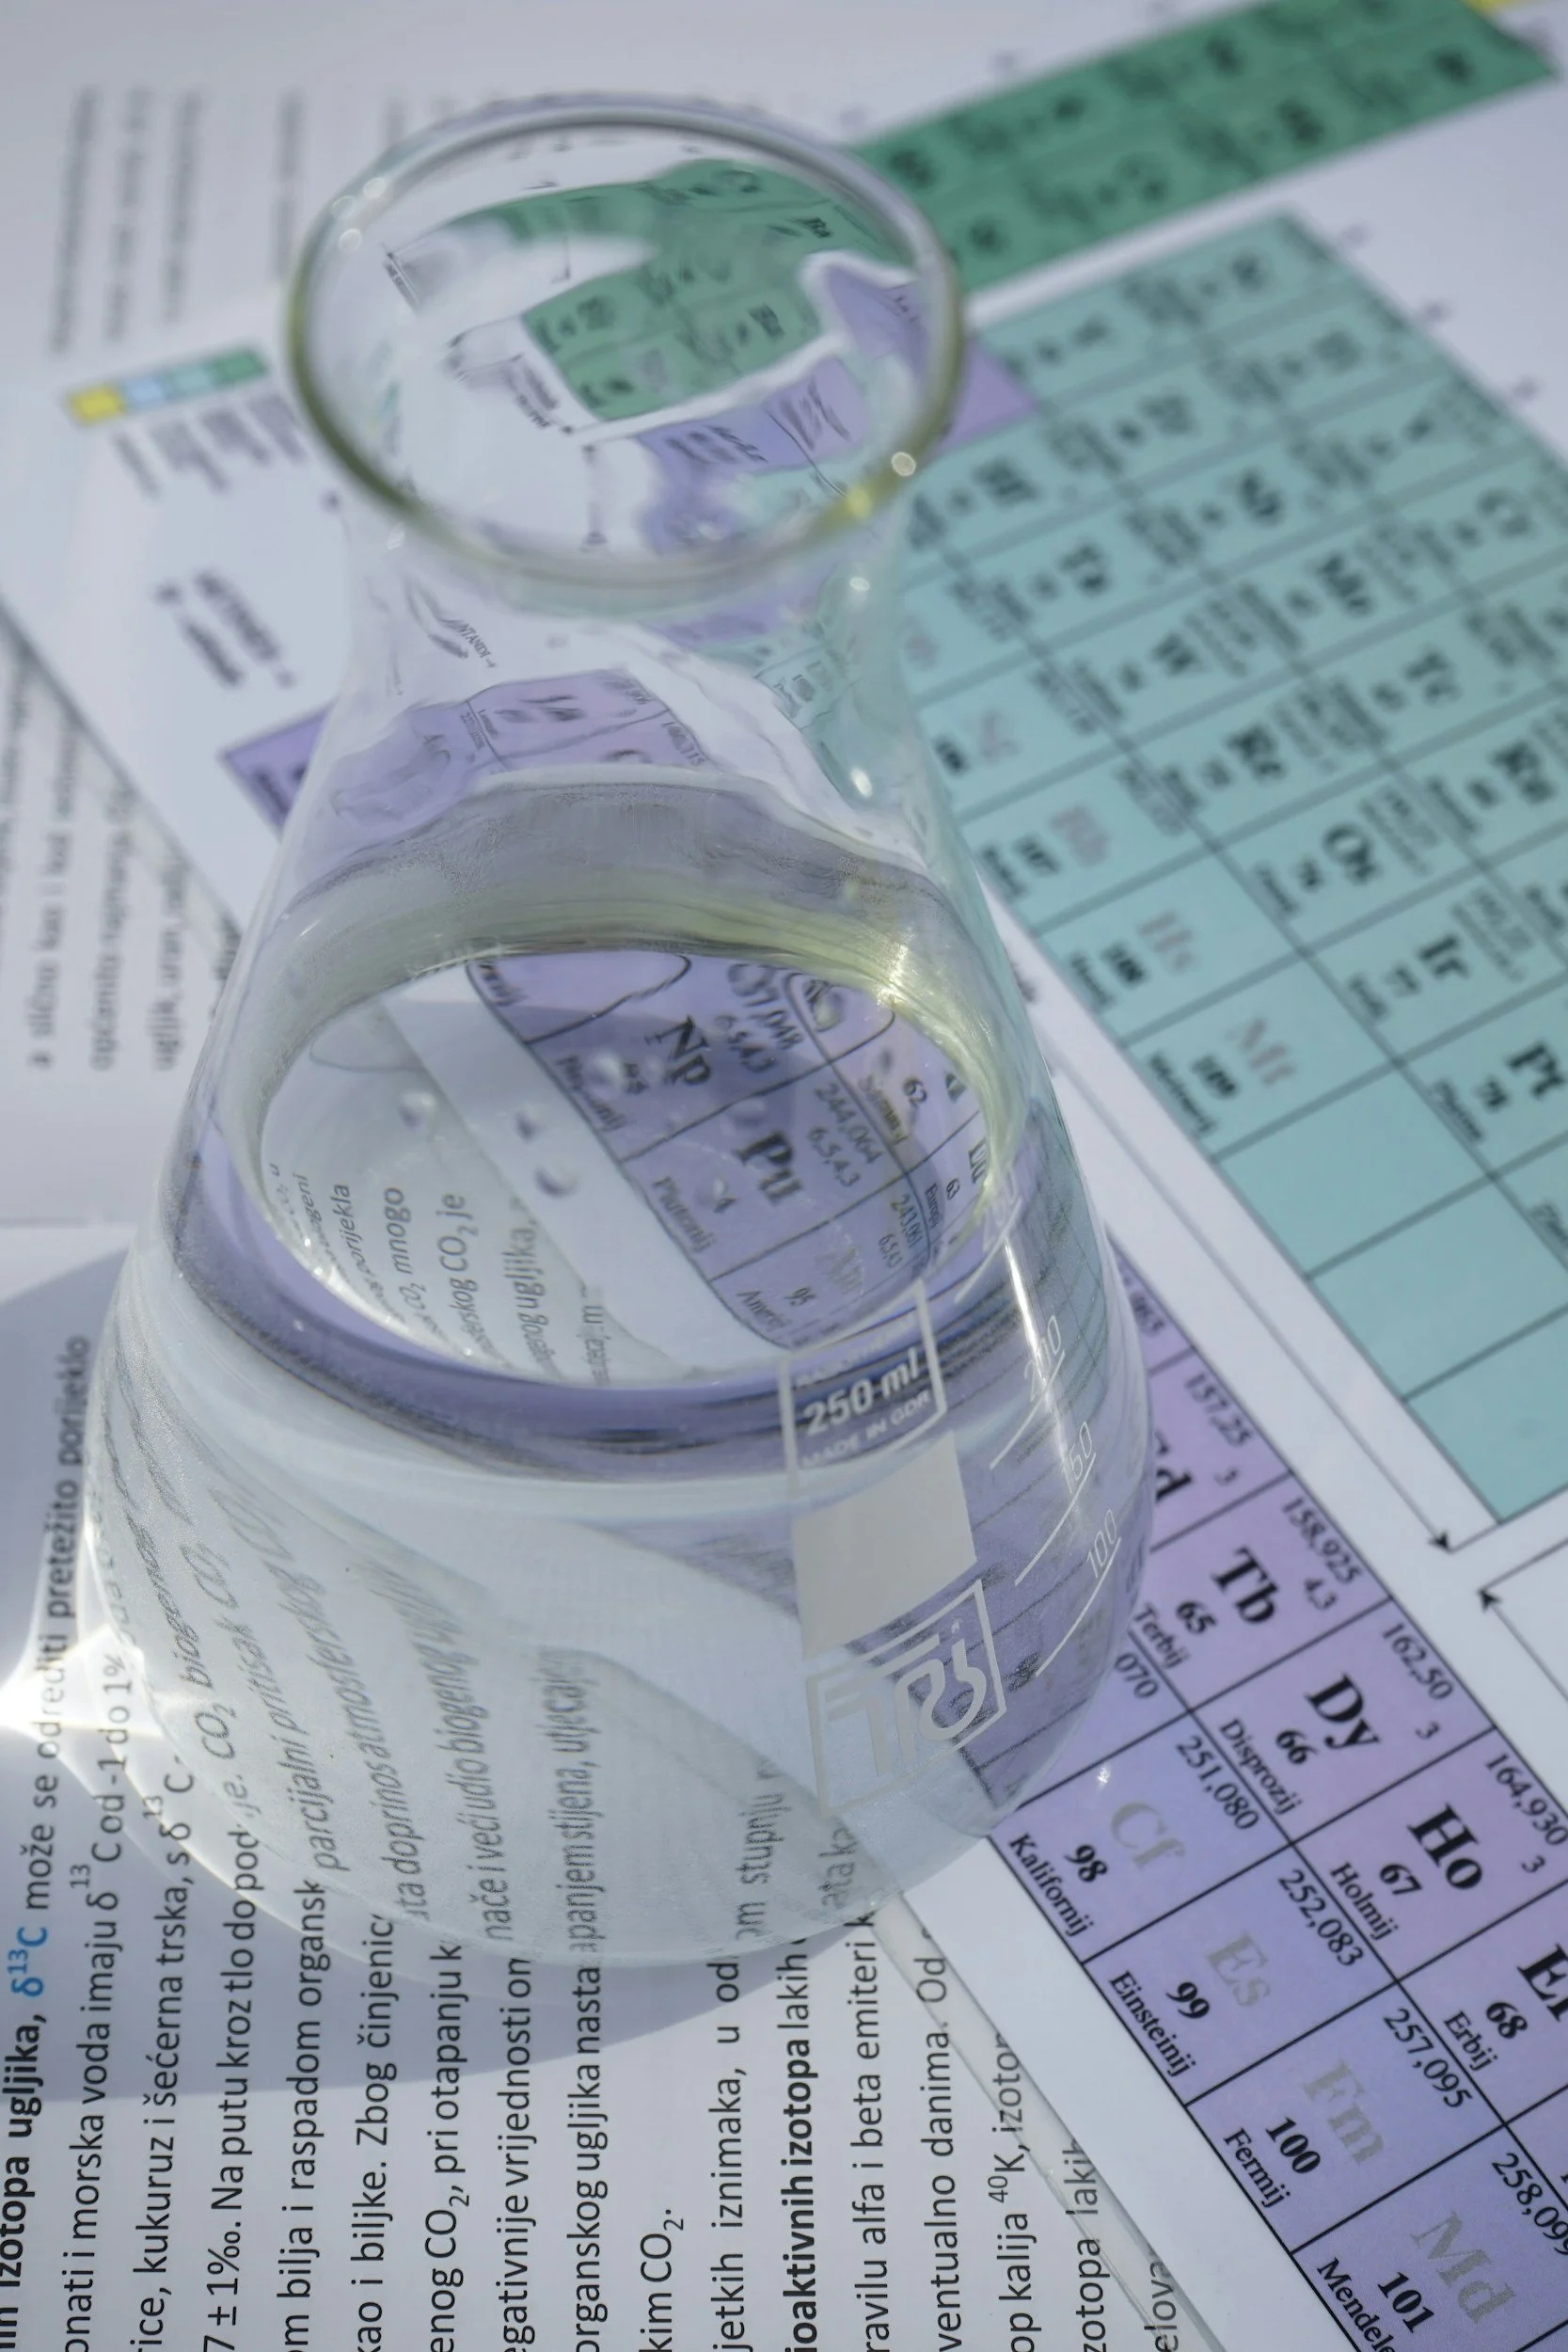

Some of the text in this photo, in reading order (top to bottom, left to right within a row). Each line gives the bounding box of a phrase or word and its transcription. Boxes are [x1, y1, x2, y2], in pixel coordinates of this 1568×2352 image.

[645, 1016, 712, 1086] Np
[814, 1084, 884, 1165] 244,064
[902, 1077, 928, 1109] 62
[734, 1132, 805, 1206] Pu
[381, 1187, 414, 1274] mnogo
[435, 1193, 479, 1272] CO2 je
[57, 1337, 90, 1467] porijeklo
[803, 1378, 873, 1437] 250
[880, 1346, 919, 1400] ml
[1183, 1373, 1254, 1449] 157,25
[1213, 1468, 1237, 1487] 3
[39, 1476, 82, 1618] pretežito
[1086, 1509, 1118, 1579] 100
[1280, 1495, 1364, 1585] 158,925
[1175, 1598, 1217, 1637] 65
[1212, 1546, 1282, 1629] Tb
[1303, 1577, 1337, 1612] 4,3
[1133, 1604, 1190, 1671] Terbij
[1383, 1622, 1453, 1702] 162,50
[28, 1629, 71, 1762] odrediti
[95, 1706, 131, 1747] do
[1307, 1674, 1382, 1750] Dy
[1416, 1721, 1440, 1740] 3
[97, 1759, 125, 1785] -1
[445, 1758, 492, 1809] udio
[1176, 1734, 1259, 1831] 251,080
[1219, 1718, 1304, 1816] Disprozij
[1276, 1727, 1319, 1766] 66
[34, 1775, 58, 1808] se
[97, 1795, 124, 1835] od
[272, 1735, 350, 1871] parcijalni
[361, 1764, 425, 1875] doprinos
[1485, 1753, 1568, 1847] 164,930
[21, 1825, 54, 1910] može
[166, 1851, 190, 1866] s
[456, 1814, 504, 1859] veći
[1065, 1843, 1108, 1883] 98
[1111, 1802, 1186, 1871] Cf
[1407, 1803, 1483, 1890] Ho
[1523, 1853, 1544, 1876] 3
[1008, 1833, 1095, 1939] Kalifornij
[1277, 1869, 1366, 1967] 252,083
[1329, 1862, 1399, 1940] Holmij
[1378, 1861, 1422, 1898] 67
[154, 1878, 193, 1965] trska,
[223, 1900, 256, 1940] do
[80, 1922, 123, 2011] imaju
[220, 1949, 254, 1993] tlo
[357, 1915, 400, 2048] činjenic
[775, 1953, 809, 2028] lakih
[846, 1943, 879, 2059] emiteri
[1165, 1980, 1211, 2020] 99
[1206, 1930, 1272, 2007] Es
[143, 1978, 182, 2106] šećerna
[216, 2000, 251, 2067] kroz
[430, 1972, 469, 2120] otapanju
[718, 2026, 739, 2043] u
[1108, 1970, 1196, 2078] Einsteinij
[1384, 2008, 1472, 2110] 257,095
[1443, 2010, 1498, 2070] Erbij
[1485, 2000, 1528, 2040] 68
[2, 2014, 46, 2137] ugljika,
[76, 2024, 109, 2104] voda
[356, 2062, 397, 2145] Zbog
[497, 2008, 537, 2186] vrijednosti
[781, 2040, 818, 2166] izotopa
[218, 2078, 252, 2154] putu
[286, 2021, 324, 2189] raspadom
[567, 2065, 608, 2170] ugljika
[850, 2075, 882, 2146] beta
[1303, 2057, 1384, 2165] Fm
[69, 2116, 103, 2238] morska
[427, 2131, 466, 2172] pri
[708, 2069, 746, 2227] iznimaka,
[914, 1953, 961, 2352] ventualno danima. Od
[1224, 2126, 1291, 2209] Fermij
[1266, 2116, 1321, 2175] 100
[133, 2137, 173, 2272] kukuruz
[211, 2167, 244, 2209] Na
[351, 2162, 393, 2261] biljke.
[852, 2185, 886, 2244] alfa
[277, 2228, 320, 2297] bilja
[997, 2214, 1037, 2300] kalija
[1076, 2239, 1110, 2352] zotopa
[1412, 2211, 1515, 2326] Md
[208, 2306, 236, 2326] ±
[710, 2254, 752, 2352] jetkih
[1378, 2271, 1433, 2334] 101
